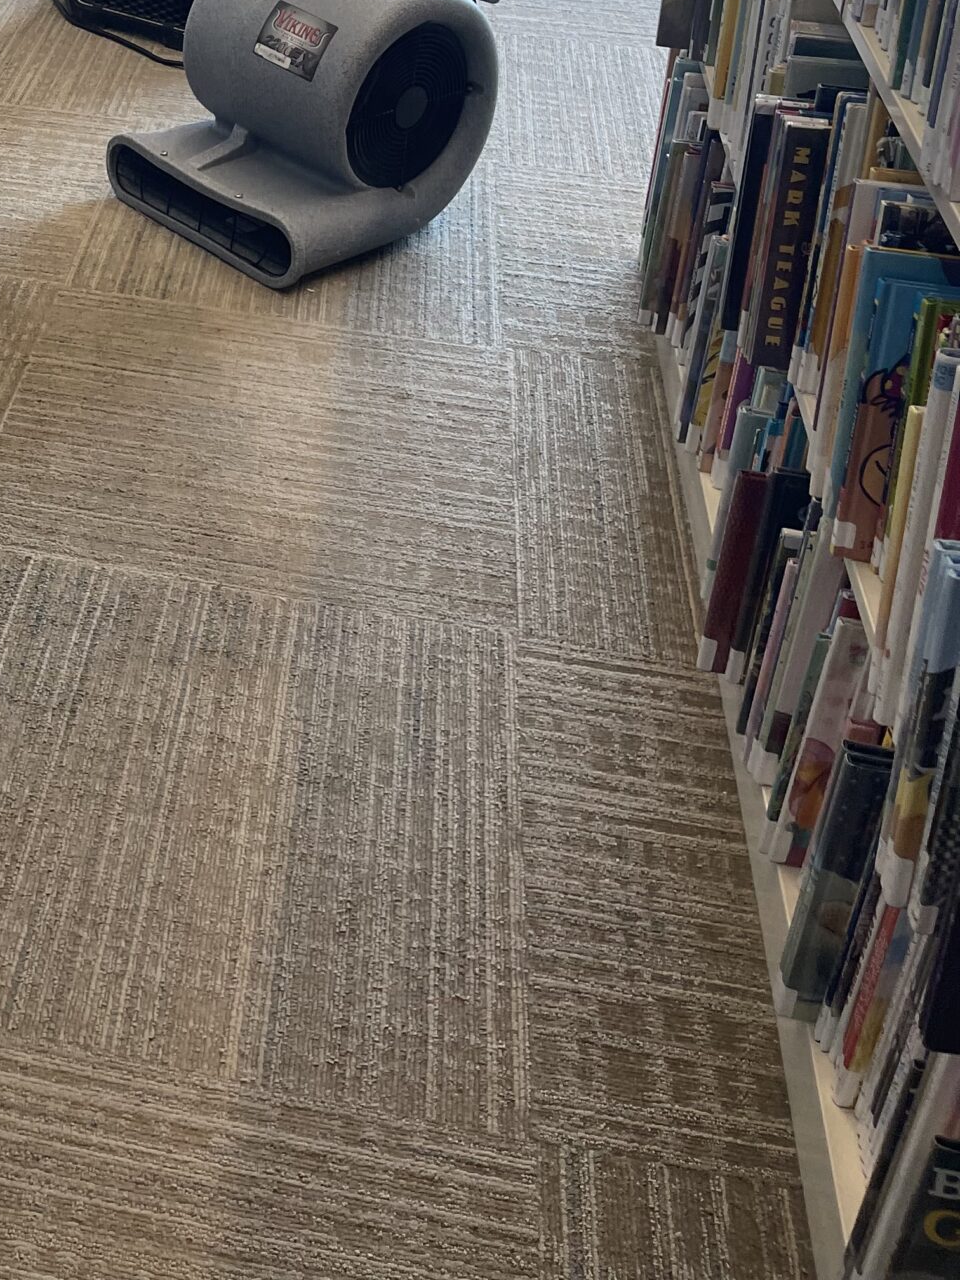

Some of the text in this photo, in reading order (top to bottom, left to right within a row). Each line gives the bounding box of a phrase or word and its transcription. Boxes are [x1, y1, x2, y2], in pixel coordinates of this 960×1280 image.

[275, 8, 321, 45] VIKING
[764, 146, 812, 347] MARK TEAGUE
